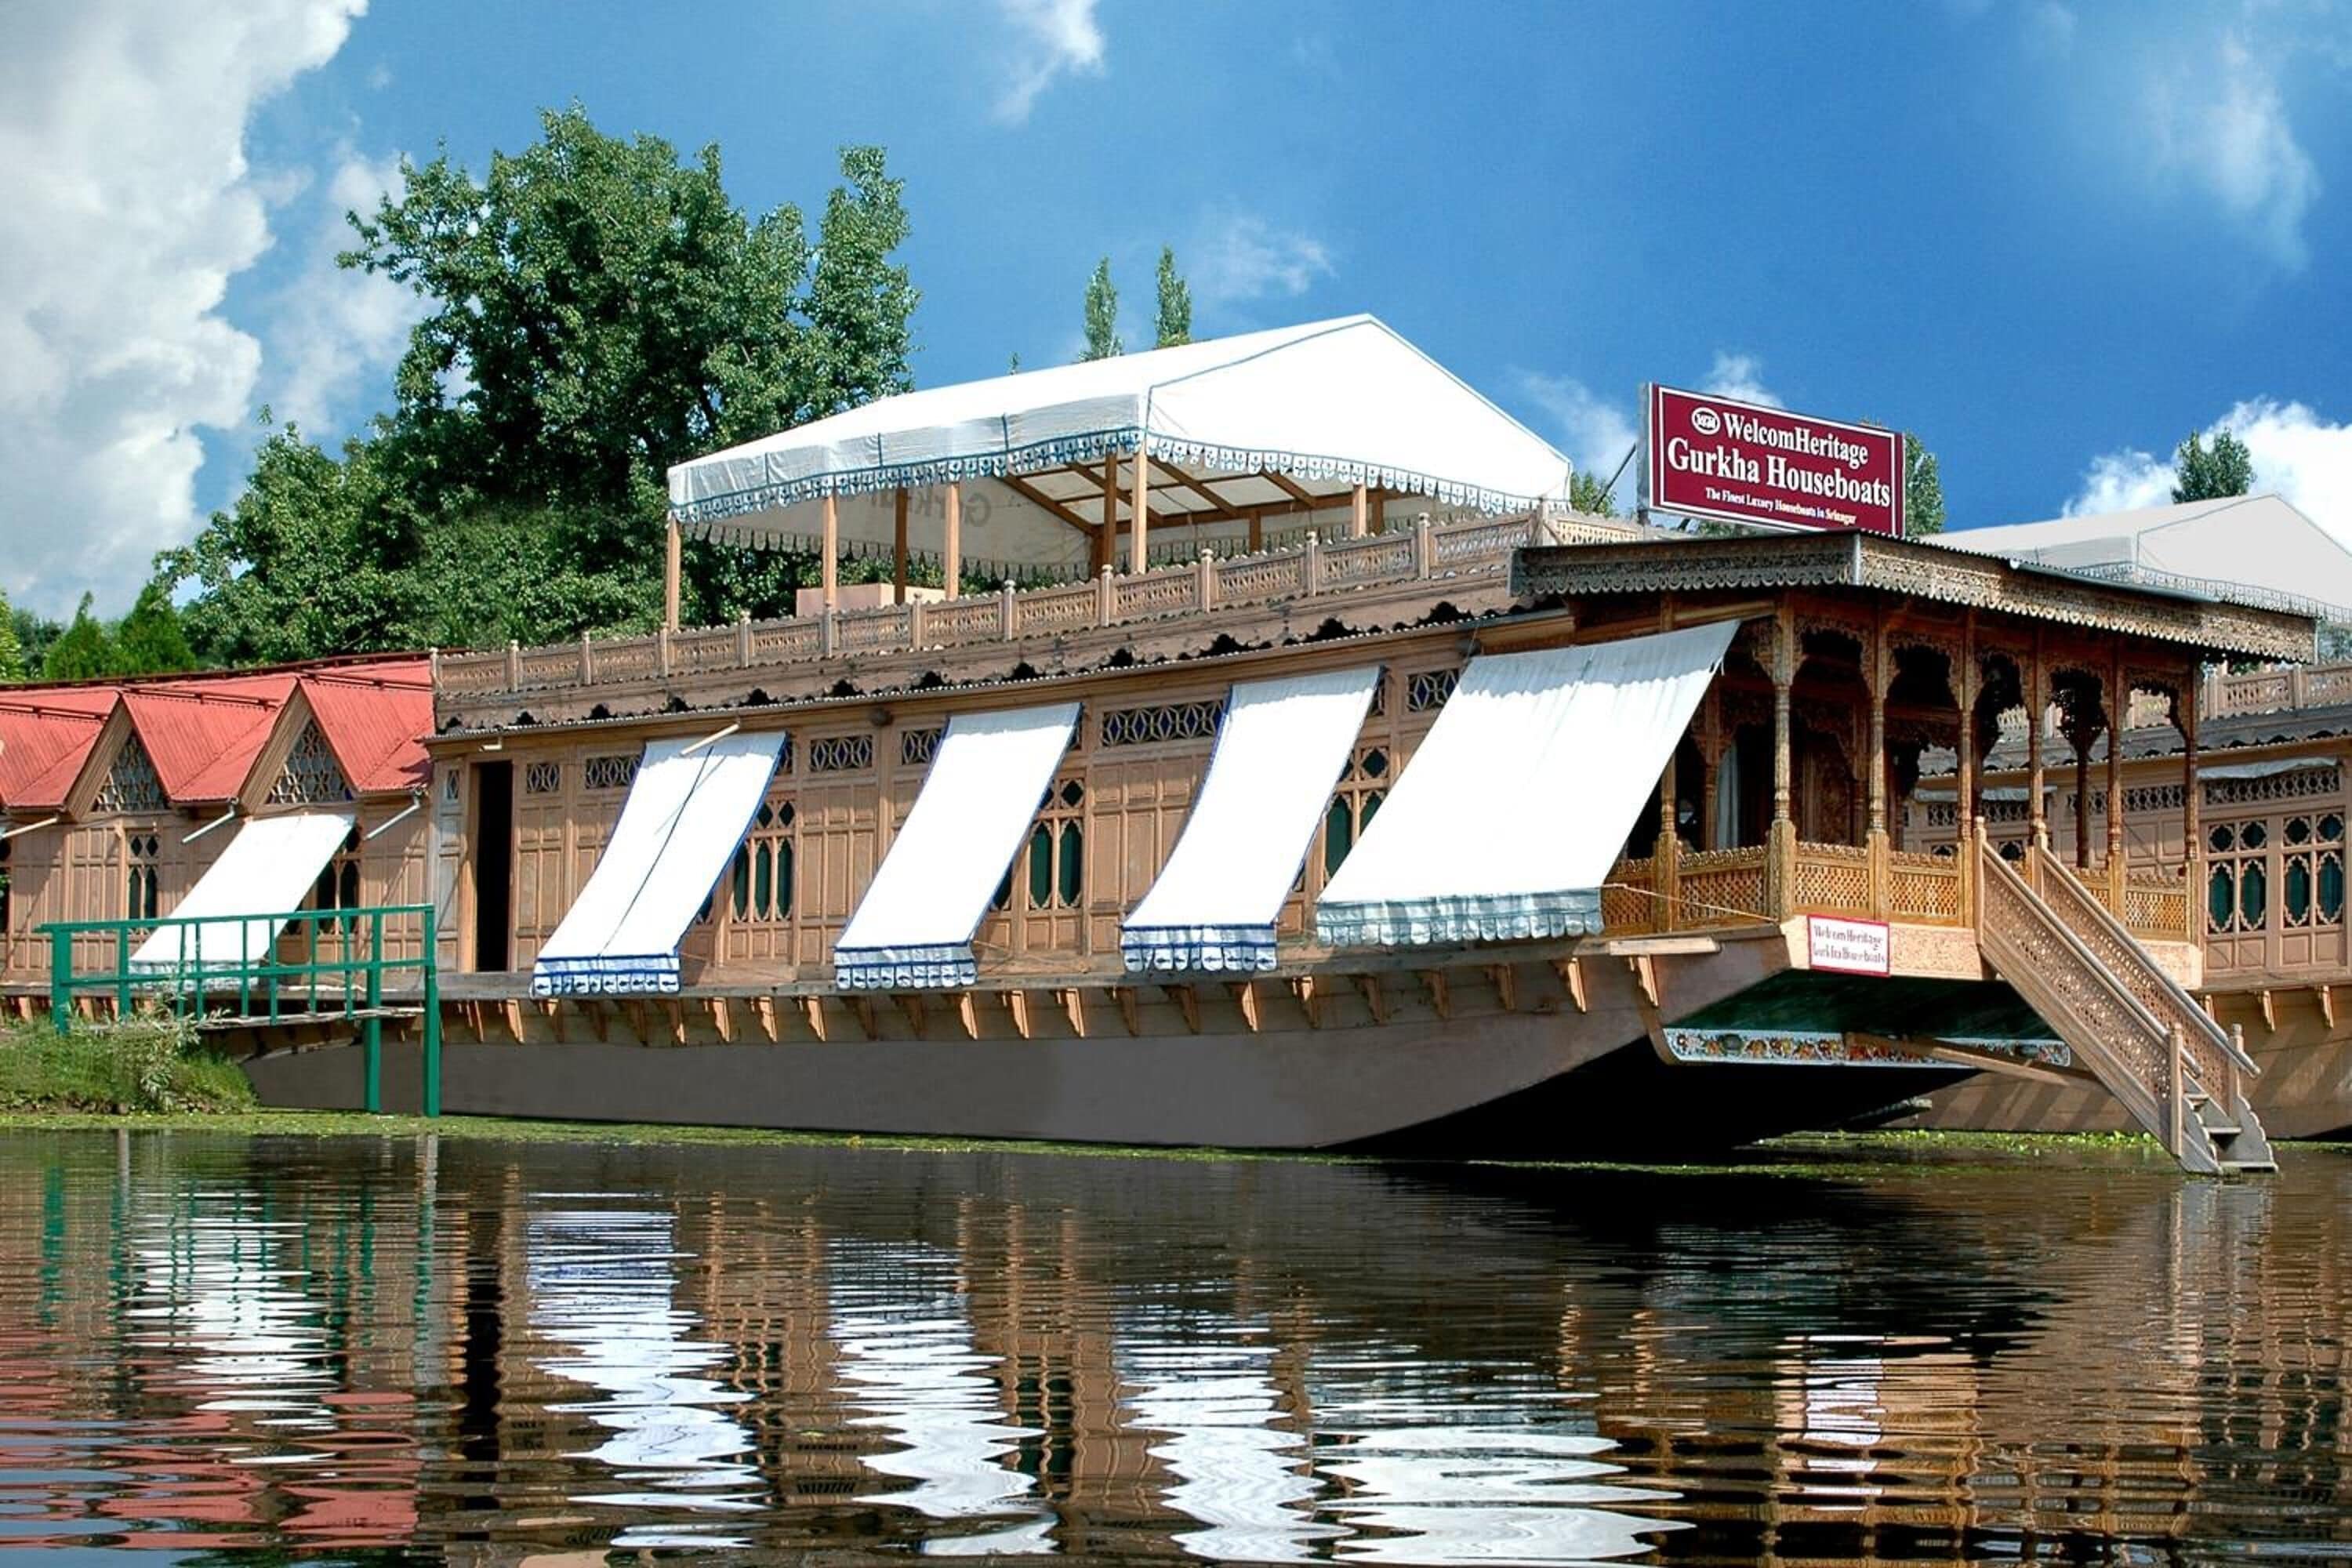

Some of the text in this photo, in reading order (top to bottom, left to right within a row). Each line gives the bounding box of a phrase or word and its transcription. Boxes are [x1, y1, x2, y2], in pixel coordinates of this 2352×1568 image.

[1723, 412, 1868, 469] WelcomHeritage
[1668, 437, 1890, 507] Gurkha Houseboats
[1705, 487, 1857, 525] The Finest Luxury Houseboats in Srinagar
